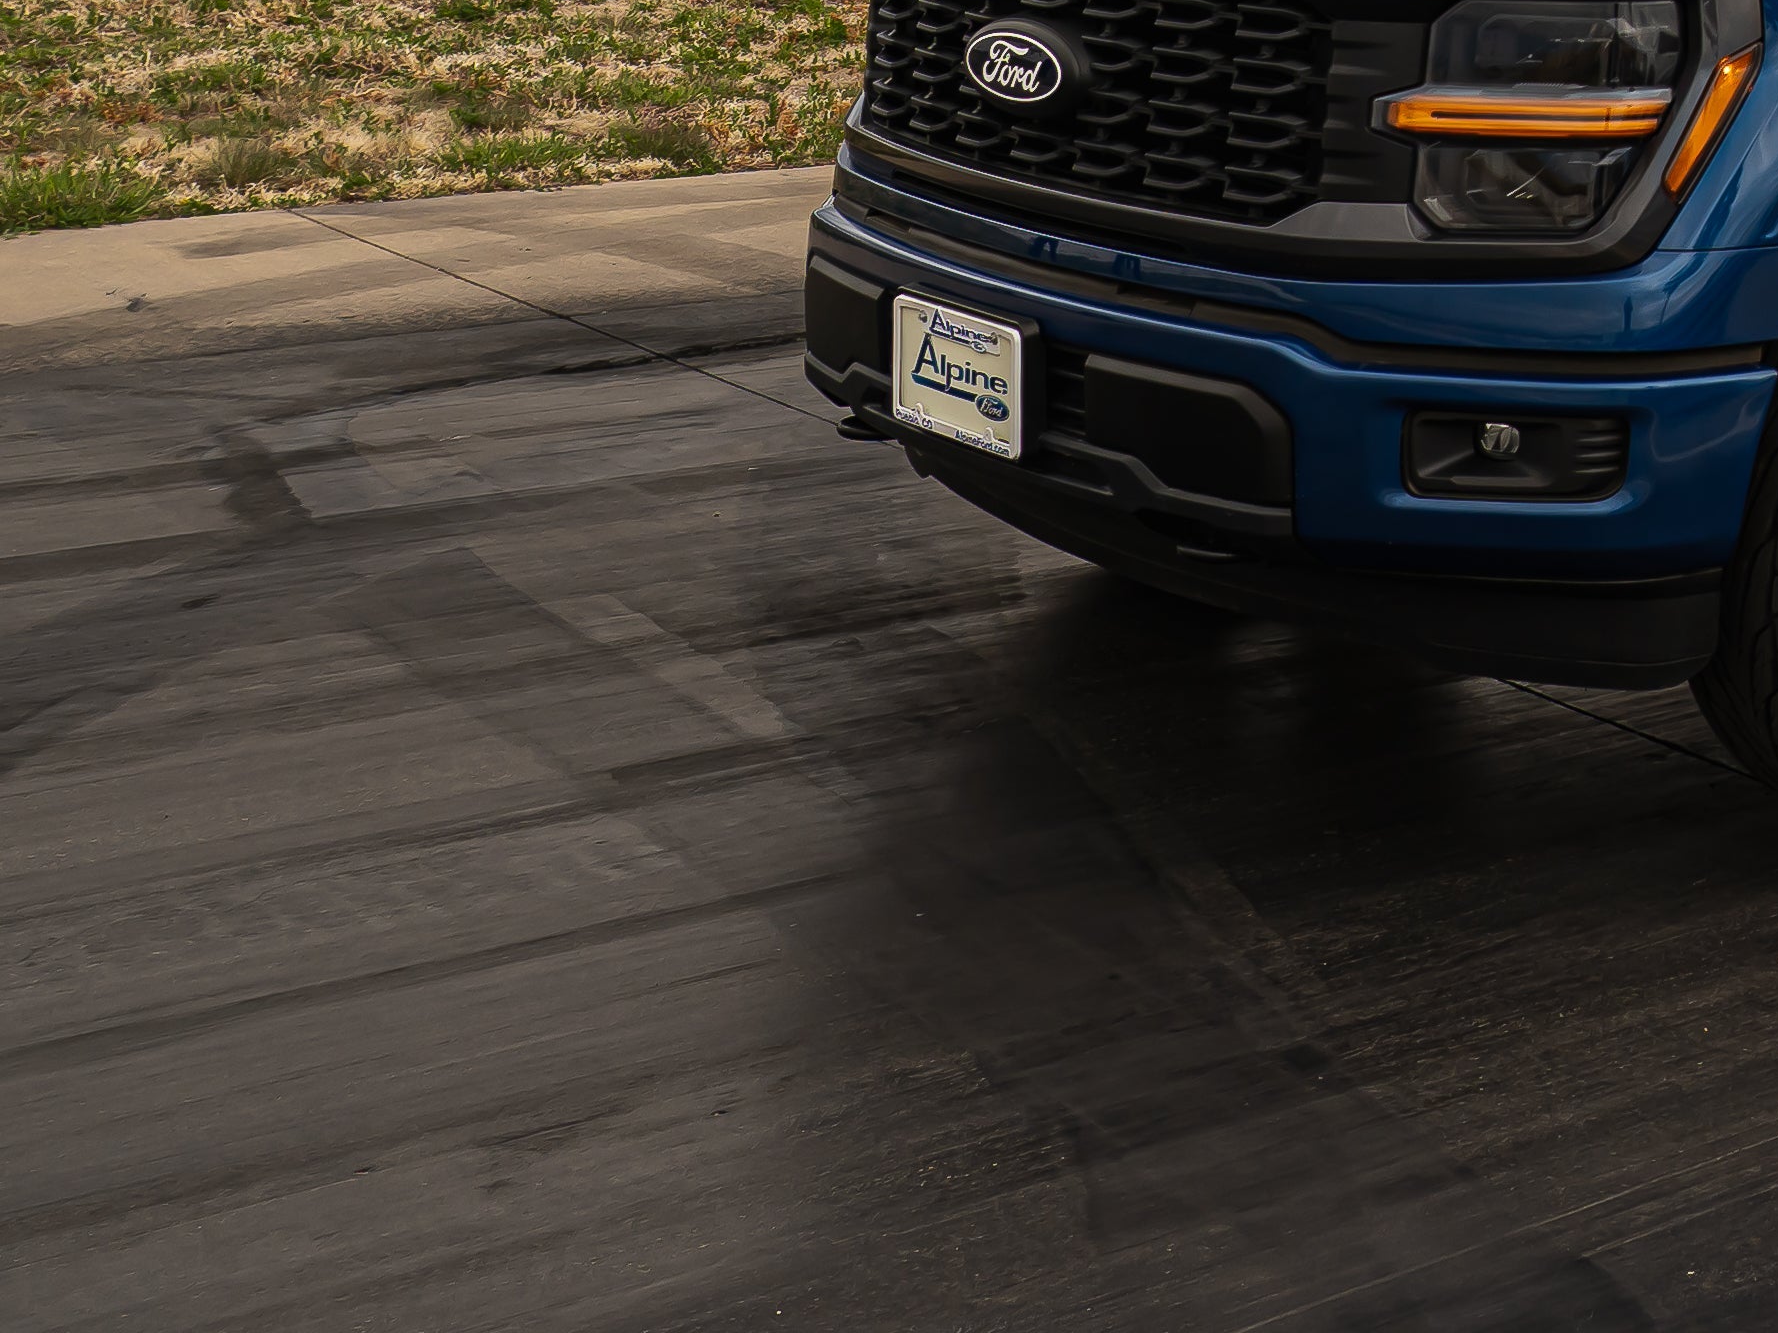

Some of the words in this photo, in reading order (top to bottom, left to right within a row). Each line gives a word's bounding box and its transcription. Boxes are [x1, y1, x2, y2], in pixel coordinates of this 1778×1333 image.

[982, 40, 1042, 93] Ford
[929, 309, 992, 343] Alpine
[912, 333, 1008, 395] Alpine
